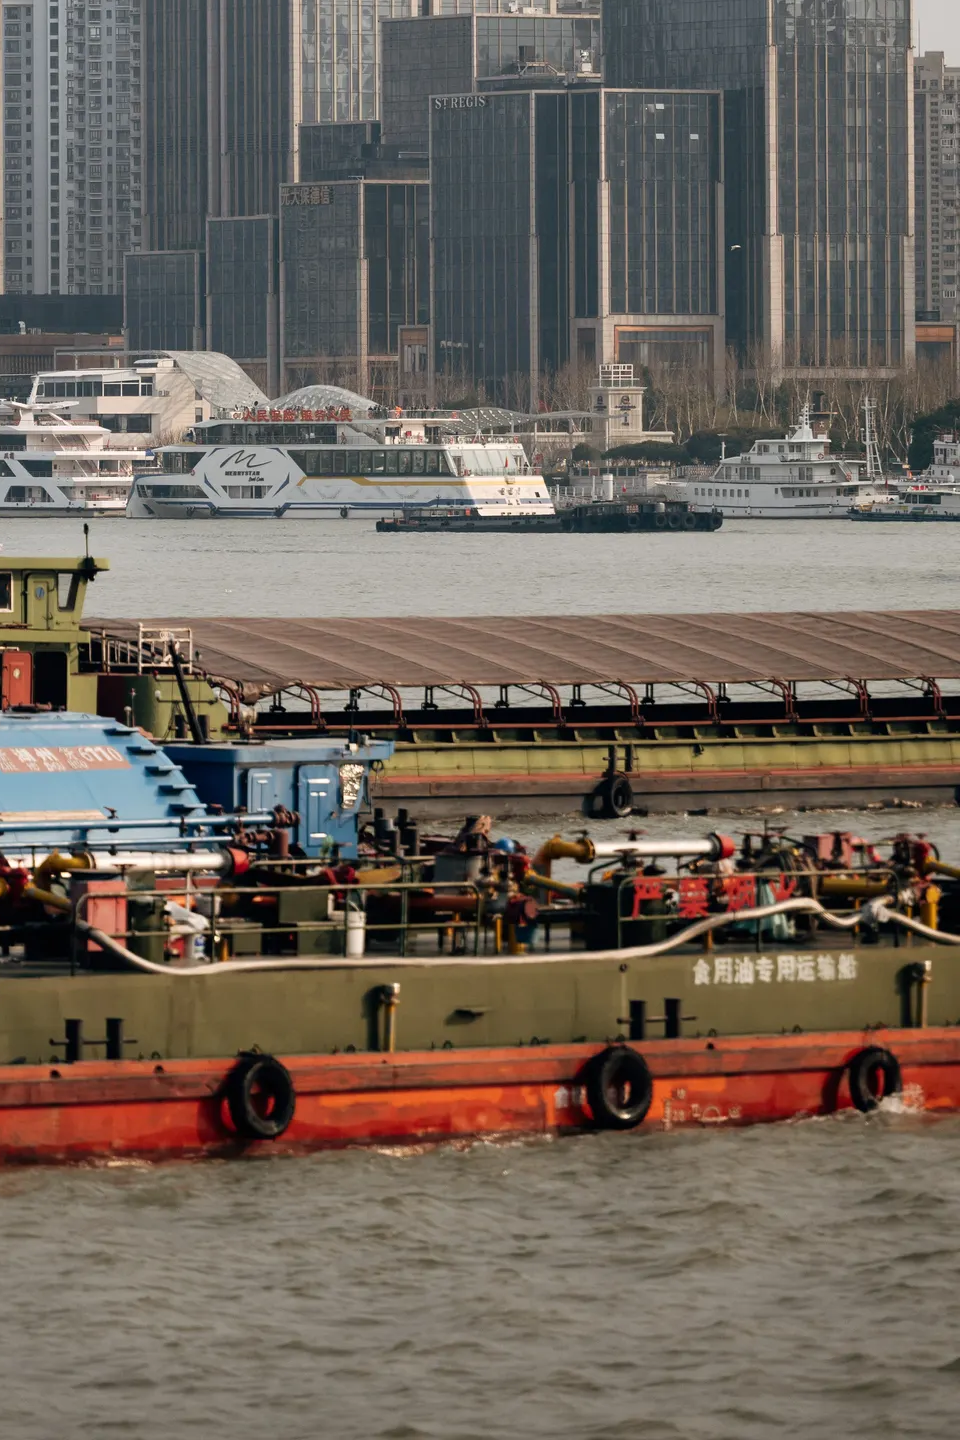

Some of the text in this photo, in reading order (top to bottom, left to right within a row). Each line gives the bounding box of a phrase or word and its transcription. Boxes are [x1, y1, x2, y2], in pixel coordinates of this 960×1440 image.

[451, 95, 486, 109] REGIS
[693, 953, 858, 985] 食用油专用运输船
